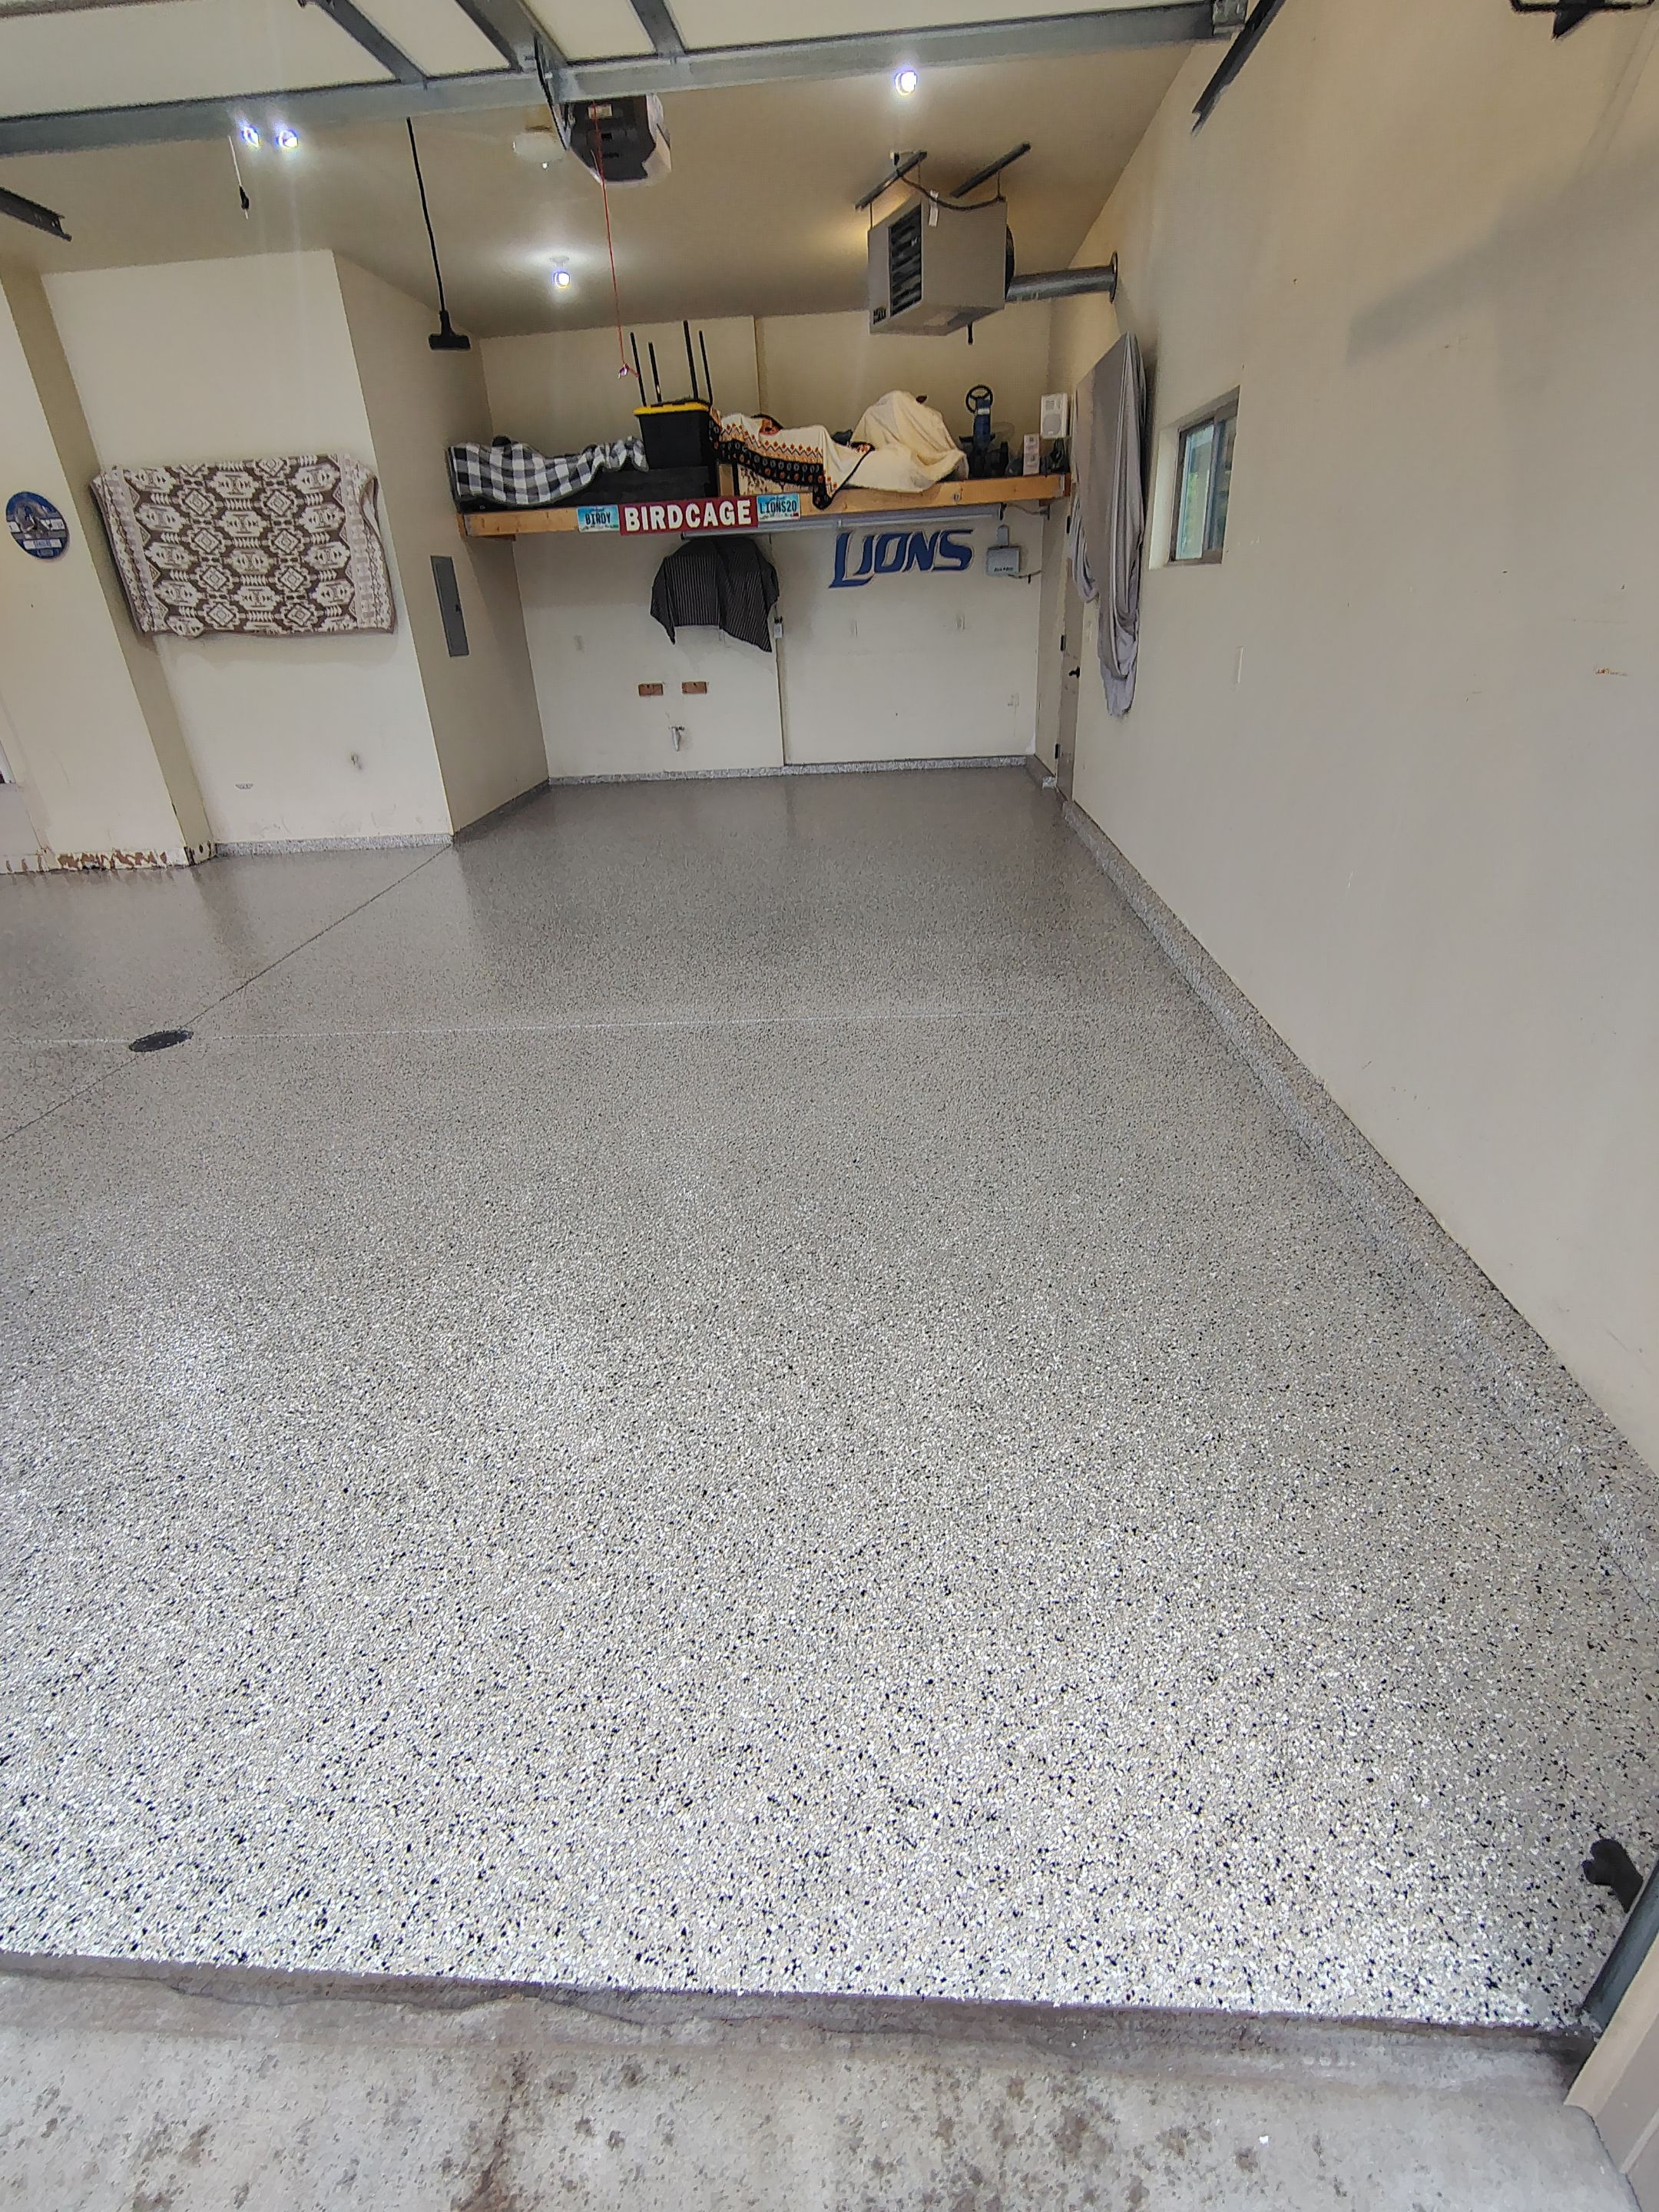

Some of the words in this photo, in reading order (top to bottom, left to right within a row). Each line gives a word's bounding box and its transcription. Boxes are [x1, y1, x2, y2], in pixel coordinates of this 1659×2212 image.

[585, 512, 611, 525] BIRDY
[624, 499, 752, 532] BIRDCAGE
[760, 500, 797, 515] LIONS20
[829, 528, 974, 589] LIONS
